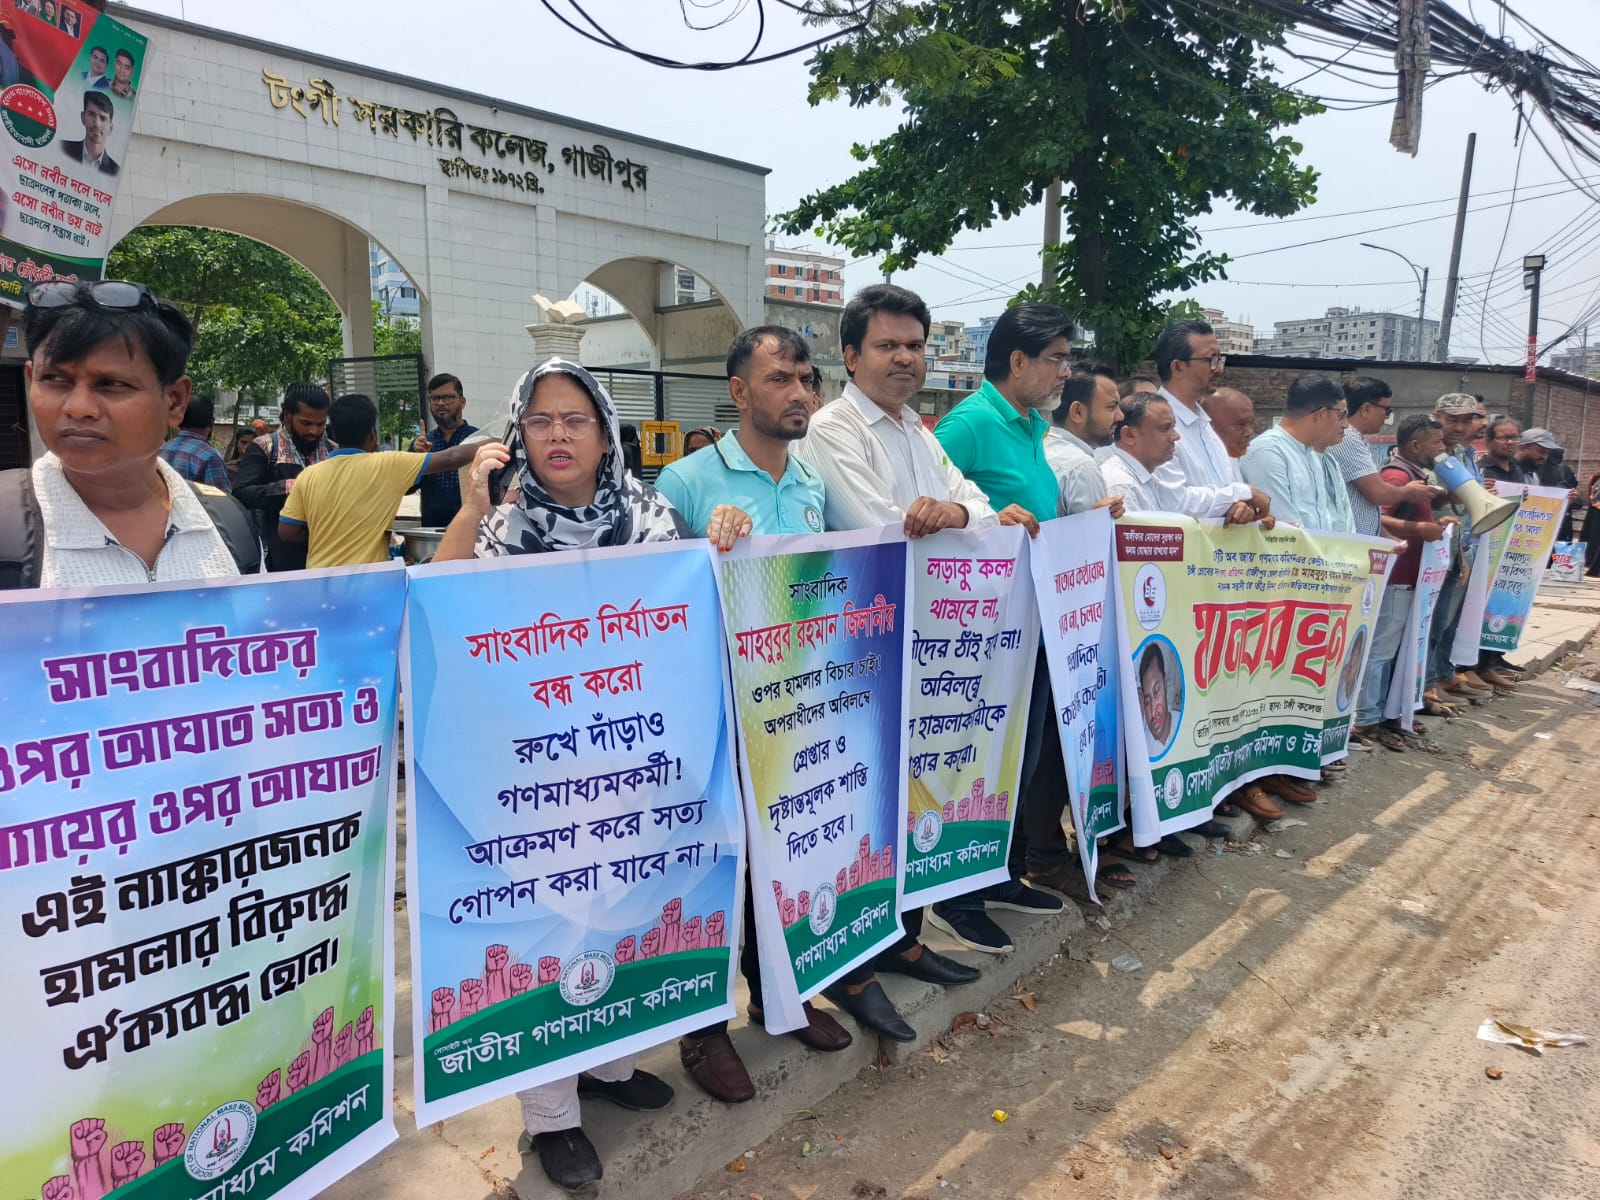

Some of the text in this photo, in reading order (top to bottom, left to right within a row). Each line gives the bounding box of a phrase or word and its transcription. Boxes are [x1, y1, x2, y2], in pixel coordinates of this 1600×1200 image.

[262, 67, 340, 127] টংগী
[349, 97, 465, 152] সরকারি
[562, 143, 648, 193] গাজীপুর
[12, 155, 112, 207] এসো নবীন দলে দলে
[12, 191, 103, 237] এসো নবীন ভয় নাই
[788, 571, 849, 604] সাংবাদিক
[926, 556, 972, 592] লড়াকু
[465, 598, 689, 665] সাংবাদিক নির্যাতন
[796, 611, 840, 651] রহমান
[843, 593, 897, 640] জিলানীর
[930, 597, 999, 628] থামবে না,
[43, 624, 318, 702] সাংবাদিকের
[911, 629, 951, 667] ীদের
[954, 630, 983, 662] ঠাঁই
[999, 628, 1022, 651] না!
[530, 660, 643, 710] বন্ধ করো
[752, 681, 781, 704] ওপর
[784, 668, 822, 697] হামলার
[825, 660, 855, 685] বিচার
[920, 670, 983, 703] অবিলম্বে
[98, 704, 255, 770] আঘাত
[262, 690, 343, 740] সত্য
[352, 686, 379, 725] ও
[512, 711, 665, 765] রুখে দাঁড়াও
[764, 702, 826, 736] অপরাধীদের
[1286, 735, 1297, 752] ও
[497, 750, 682, 814] গণমাধ্যমকর্মী!
[793, 735, 846, 774] গ্রেপ্তার ও
[908, 751, 940, 780] প্তার
[149, 775, 241, 828] ওপর
[247, 744, 384, 808] আঘাত!
[768, 762, 869, 834] দৃষ্টান্তমূলক শাস্তি
[465, 799, 708, 867] আক্রমণ করে সত্য
[787, 827, 818, 862] দিতে
[822, 813, 848, 844] হবে
[956, 839, 1001, 865] কমিশন
[22, 811, 362, 939] এই ন্যাক্কারজনক
[449, 876, 540, 925] গোপন
[546, 860, 602, 897] করা
[608, 850, 669, 885] যাবে
[675, 841, 705, 868] না
[39, 872, 351, 1007] হামলার বিরুদ্ধে
[795, 925, 848, 975] গণমাধ্যম
[849, 900, 890, 939] কমিশন
[62, 936, 339, 1070] ঐক্যবদ্ধ হোন।
[437, 970, 718, 1075] জাতীয় গণমাধ্যম কমিশন
[286, 1083, 370, 1156] কমিশন
